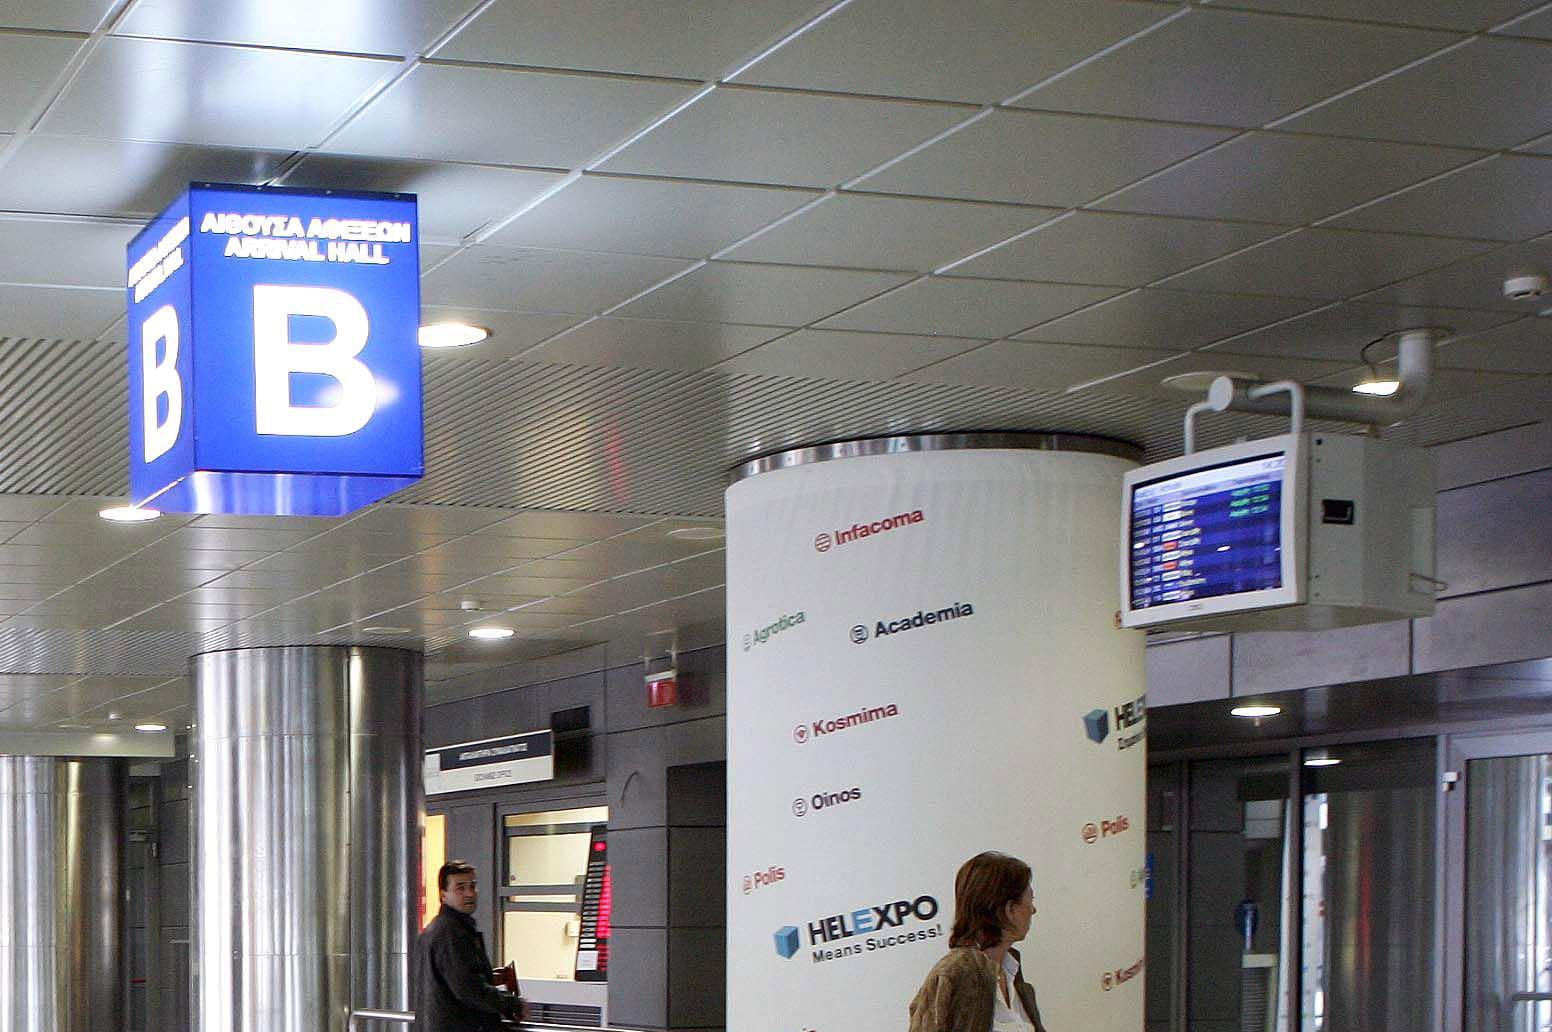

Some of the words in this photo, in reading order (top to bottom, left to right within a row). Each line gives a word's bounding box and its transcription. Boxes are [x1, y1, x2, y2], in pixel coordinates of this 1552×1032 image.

[224, 237, 325, 262] ARRIVAL
[327, 241, 390, 265] HALL
[252, 283, 377, 437] B
[142, 304, 183, 464] B
[834, 509, 925, 546] Infacoma
[752, 610, 806, 645] Agrotica
[874, 601, 974, 639] Academia
[812, 703, 898, 737] Kosmima
[811, 787, 861, 811] Oinos
[1100, 815, 1130, 838] Polis
[753, 865, 785, 889] Polis
[808, 895, 938, 946] HELEXPO
[812, 944, 862, 964] Means
[865, 923, 943, 952] Success!
